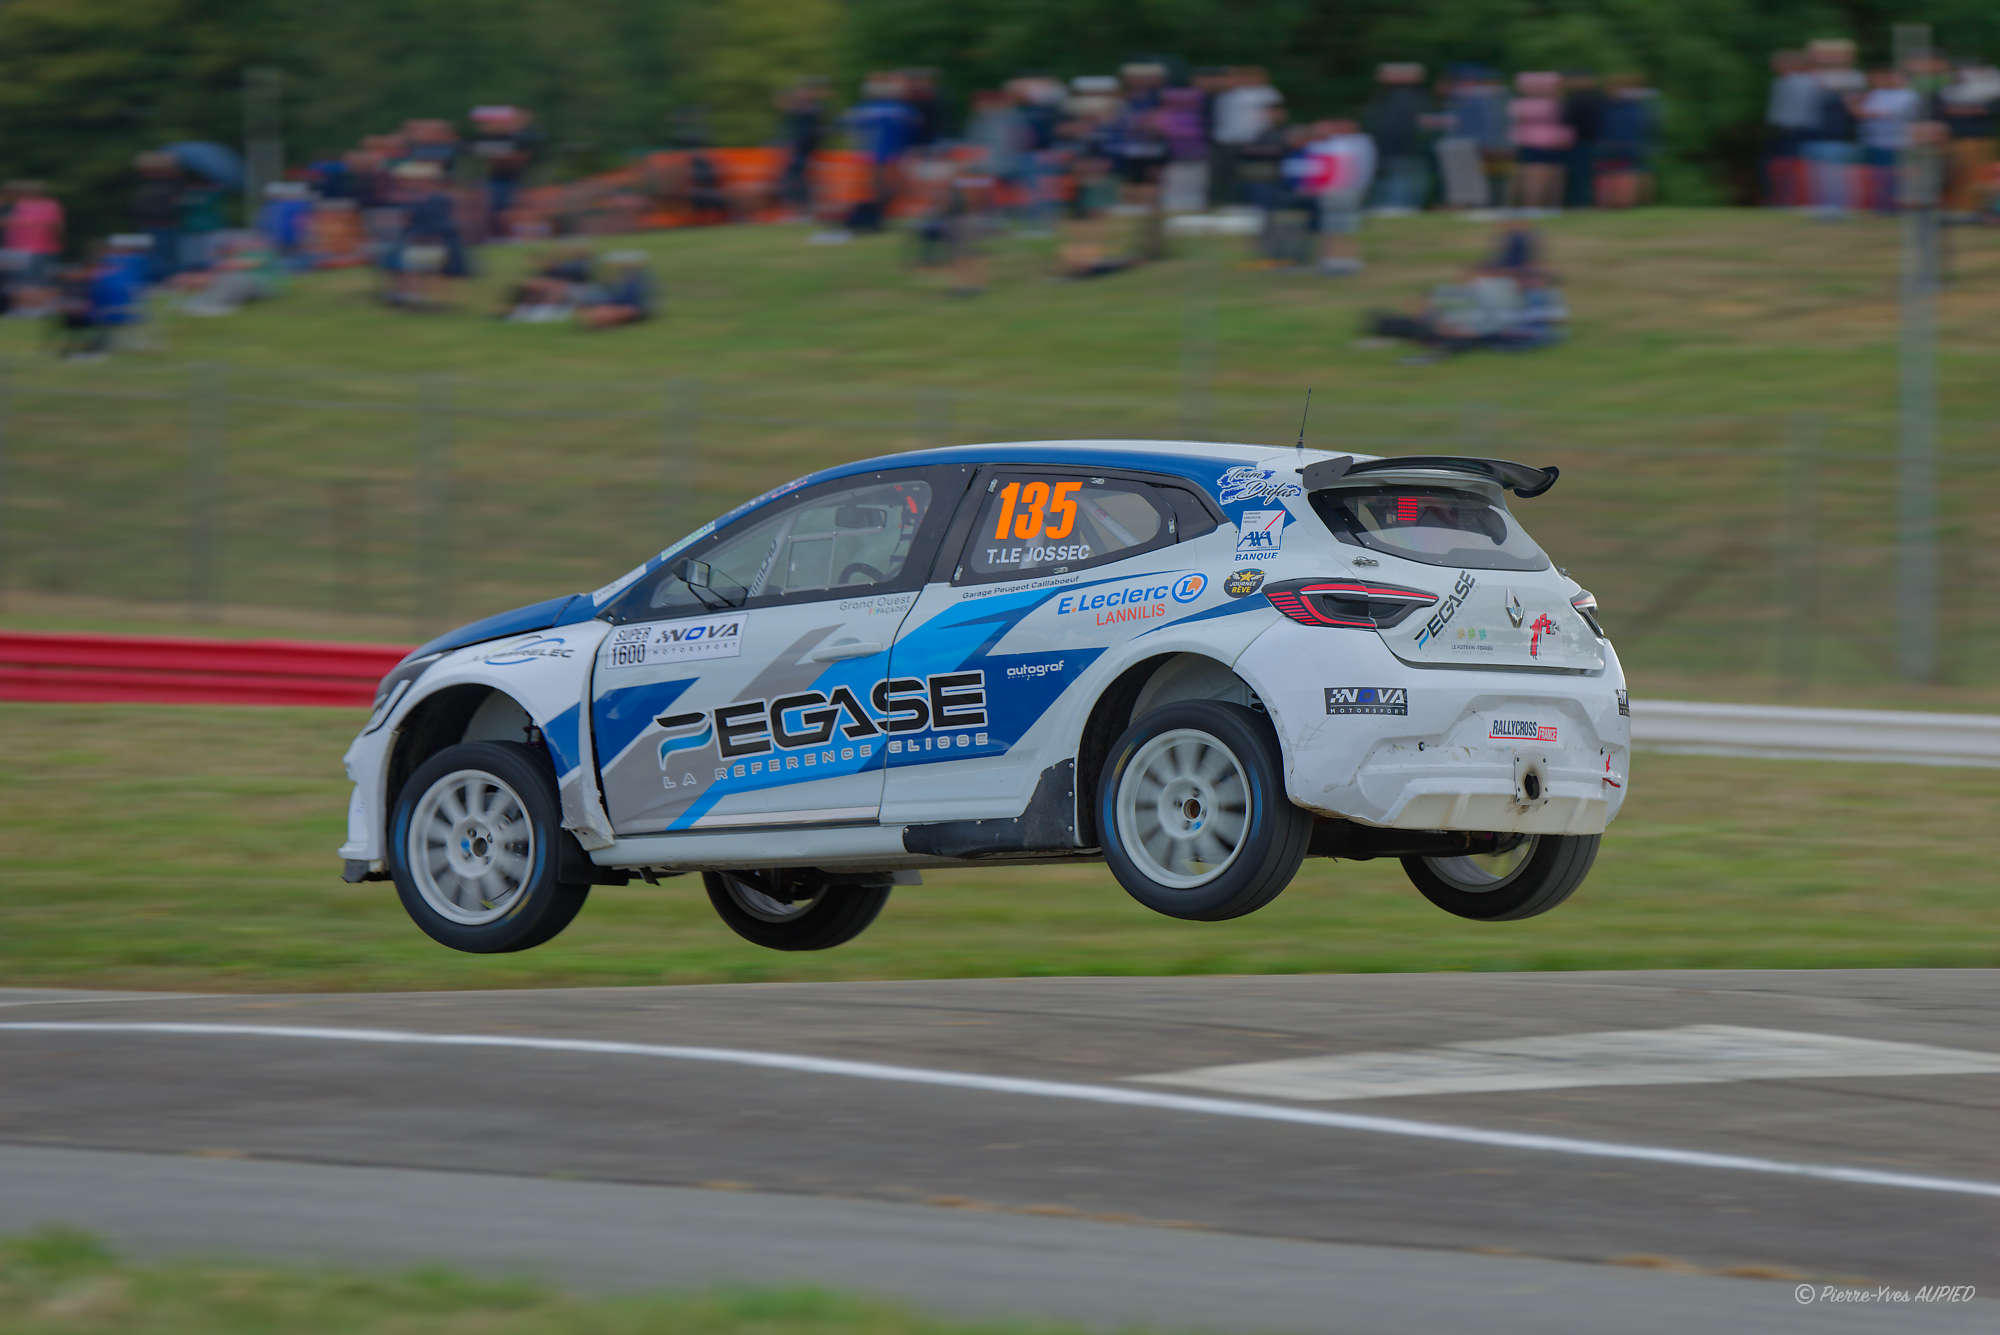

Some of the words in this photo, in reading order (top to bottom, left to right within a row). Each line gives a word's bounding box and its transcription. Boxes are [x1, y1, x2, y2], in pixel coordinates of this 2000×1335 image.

[994, 481, 1083, 540] 135
[1238, 531, 1272, 546] AXA
[987, 547, 1022, 564] T.LE
[1025, 544, 1090, 562] JOSSEC
[1234, 552, 1279, 561] BANQUE
[962, 589, 992, 599] Garage
[994, 584, 1029, 595] Peugeot
[1057, 585, 1168, 615] E.Leclerc
[1096, 603, 1165, 626] LANNILIS
[615, 626, 652, 643] SUPER
[655, 623, 740, 643] NOVA
[611, 643, 646, 666] 1600
[1006, 660, 1064, 677] autograf
[1330, 688, 1405, 704] NOVA
[653, 669, 988, 771] PEGASE
[1492, 720, 1537, 737] RALLYCROSS
[663, 773, 697, 789] LA
[714, 745, 872, 781] REFERENCE
[888, 733, 988, 754] GLISSE
